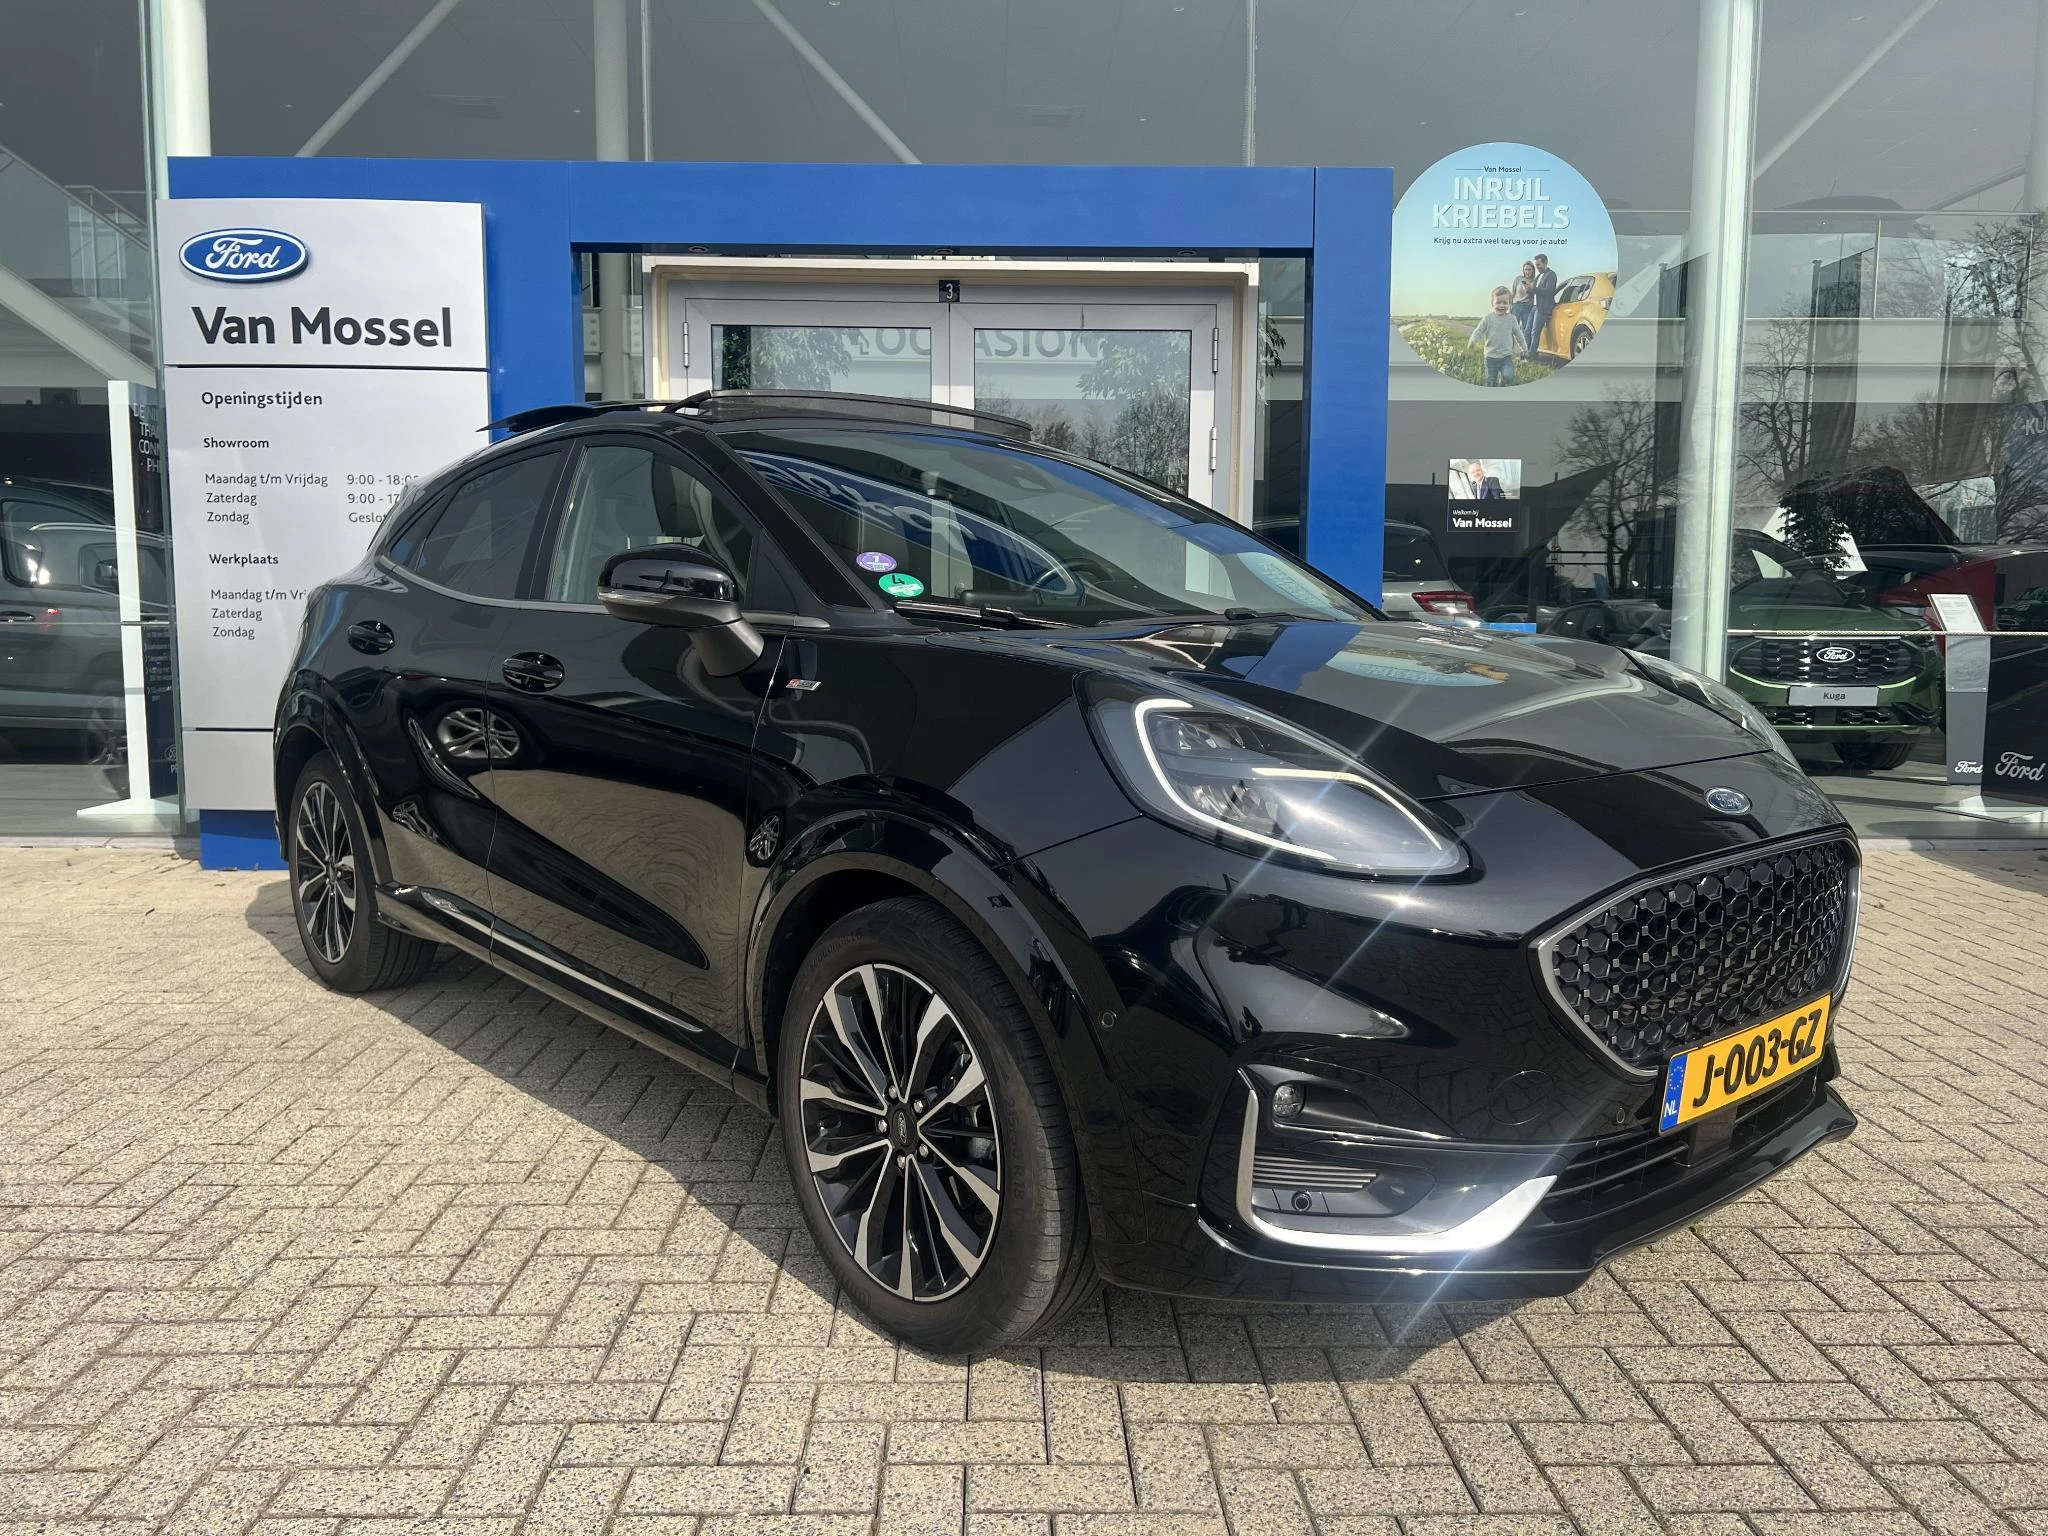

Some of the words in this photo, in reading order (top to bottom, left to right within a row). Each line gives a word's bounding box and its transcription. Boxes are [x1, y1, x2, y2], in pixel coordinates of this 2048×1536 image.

[1454, 177, 1551, 201] INRUIL
[1433, 204, 1570, 230] KRIEBELS
[1433, 237, 1451, 245] Krijg
[1484, 237, 1499, 245] veel
[1500, 238, 1521, 246] terug
[1539, 238, 1547, 246] je
[205, 238, 280, 270] Ford
[946, 283, 953, 299] 3
[191, 306, 275, 344] Van
[291, 306, 452, 347] Mossel
[201, 392, 323, 408] Openingstijden
[203, 437, 270, 449] Showroom
[205, 473, 257, 487] Maandag
[260, 474, 282, 485] t/m
[285, 473, 329, 488] Vrijdag
[346, 474, 375, 485] 9:00
[206, 492, 257, 507] Zaterdag
[347, 493, 375, 504] 9:00
[207, 511, 250, 526] Zondag
[1452, 518, 1472, 528] Van
[1475, 518, 1512, 528] Mossel
[209, 553, 279, 567] Werkplaats
[211, 589, 263, 603] Maandag
[265, 590, 287, 600] t/m
[212, 607, 263, 622] Zaterdag
[213, 626, 255, 640] Zondag
[1823, 650, 1849, 660] Ford
[1823, 692, 1846, 701] Kuga
[1954, 760, 1984, 774] Ford
[1995, 751, 2046, 781] Ford
[1692, 1008, 1823, 1109] J-003-GZ
[1663, 1100, 1678, 1118] NL
